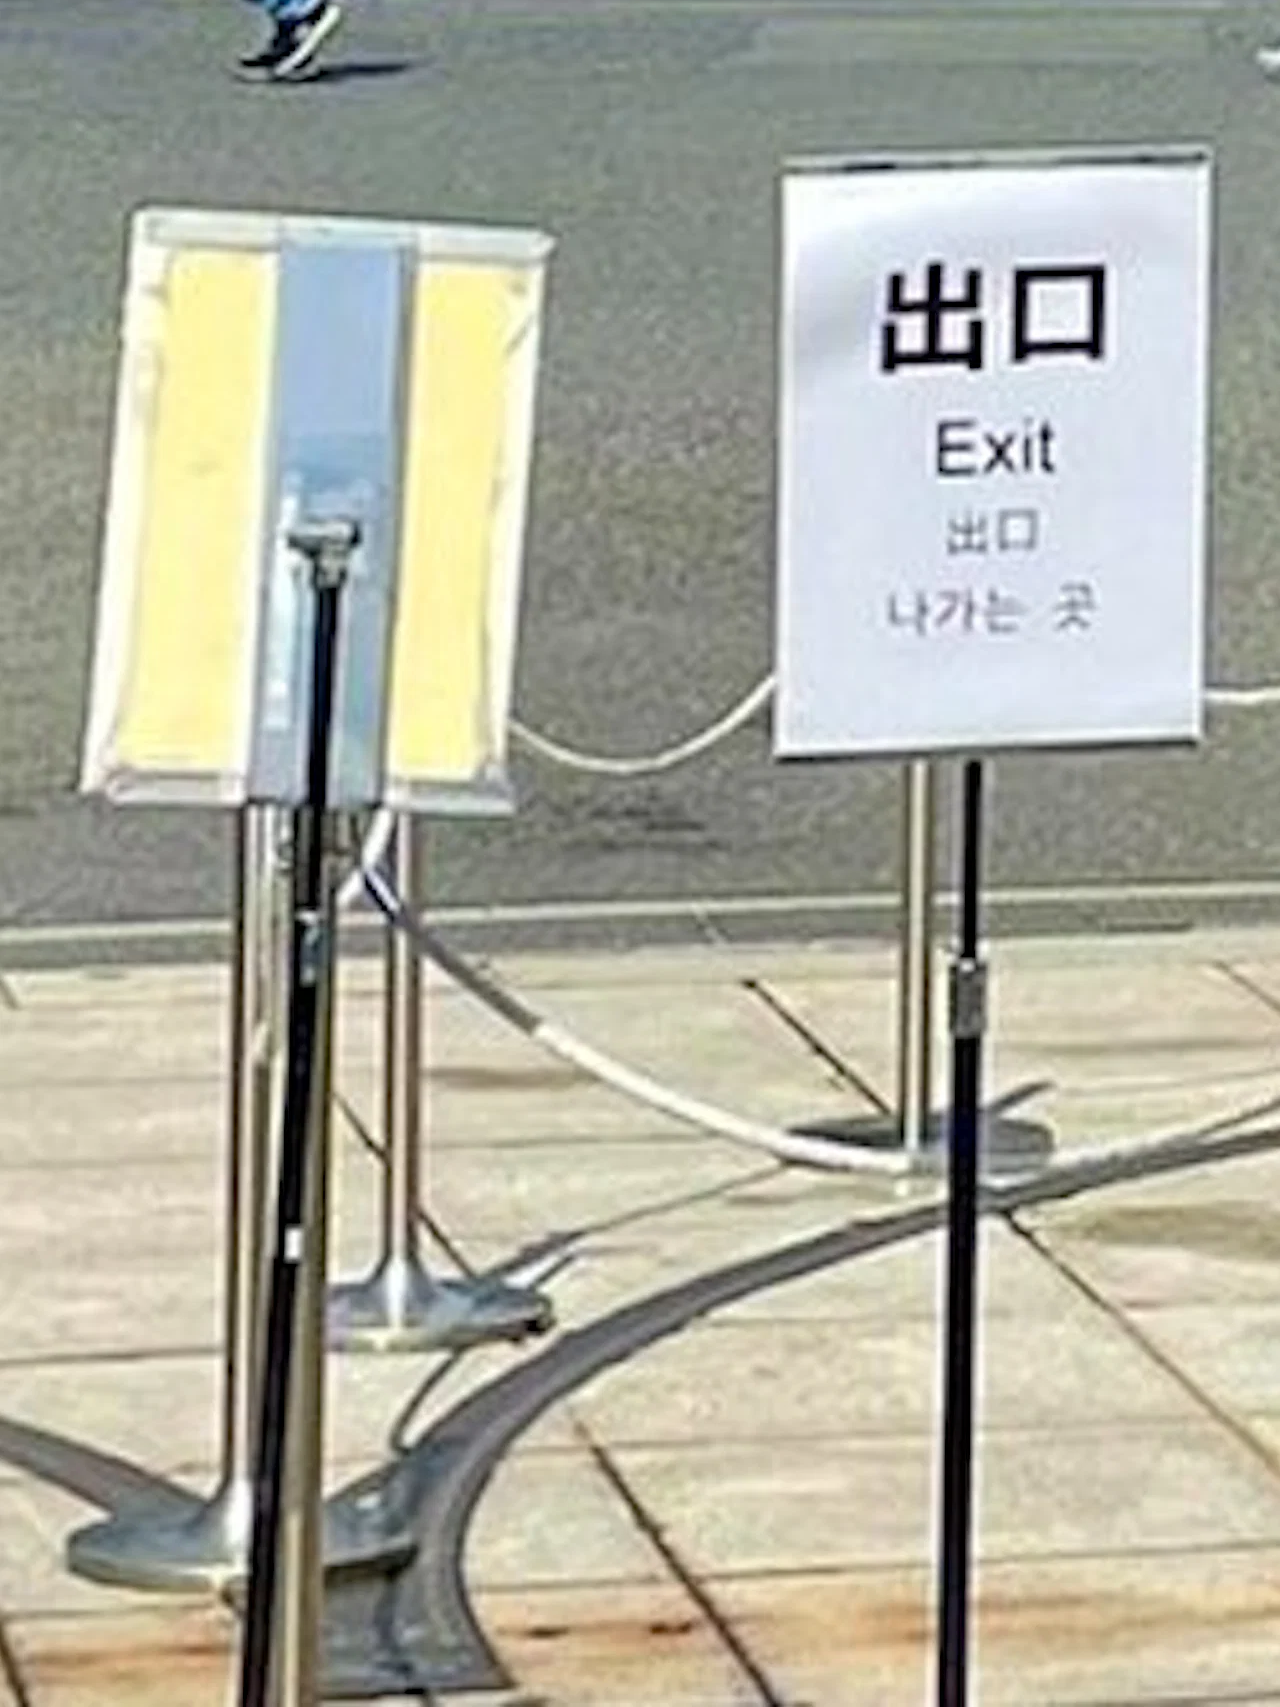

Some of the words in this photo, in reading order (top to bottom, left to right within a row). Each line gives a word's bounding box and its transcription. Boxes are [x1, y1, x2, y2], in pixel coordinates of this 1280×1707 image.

[881, 262, 1105, 373] 出口
[937, 421, 1053, 476] Exit
[948, 510, 1036, 555] 出口
[888, 589, 1020, 635] 나가는
[1055, 583, 1096, 630] 곳
